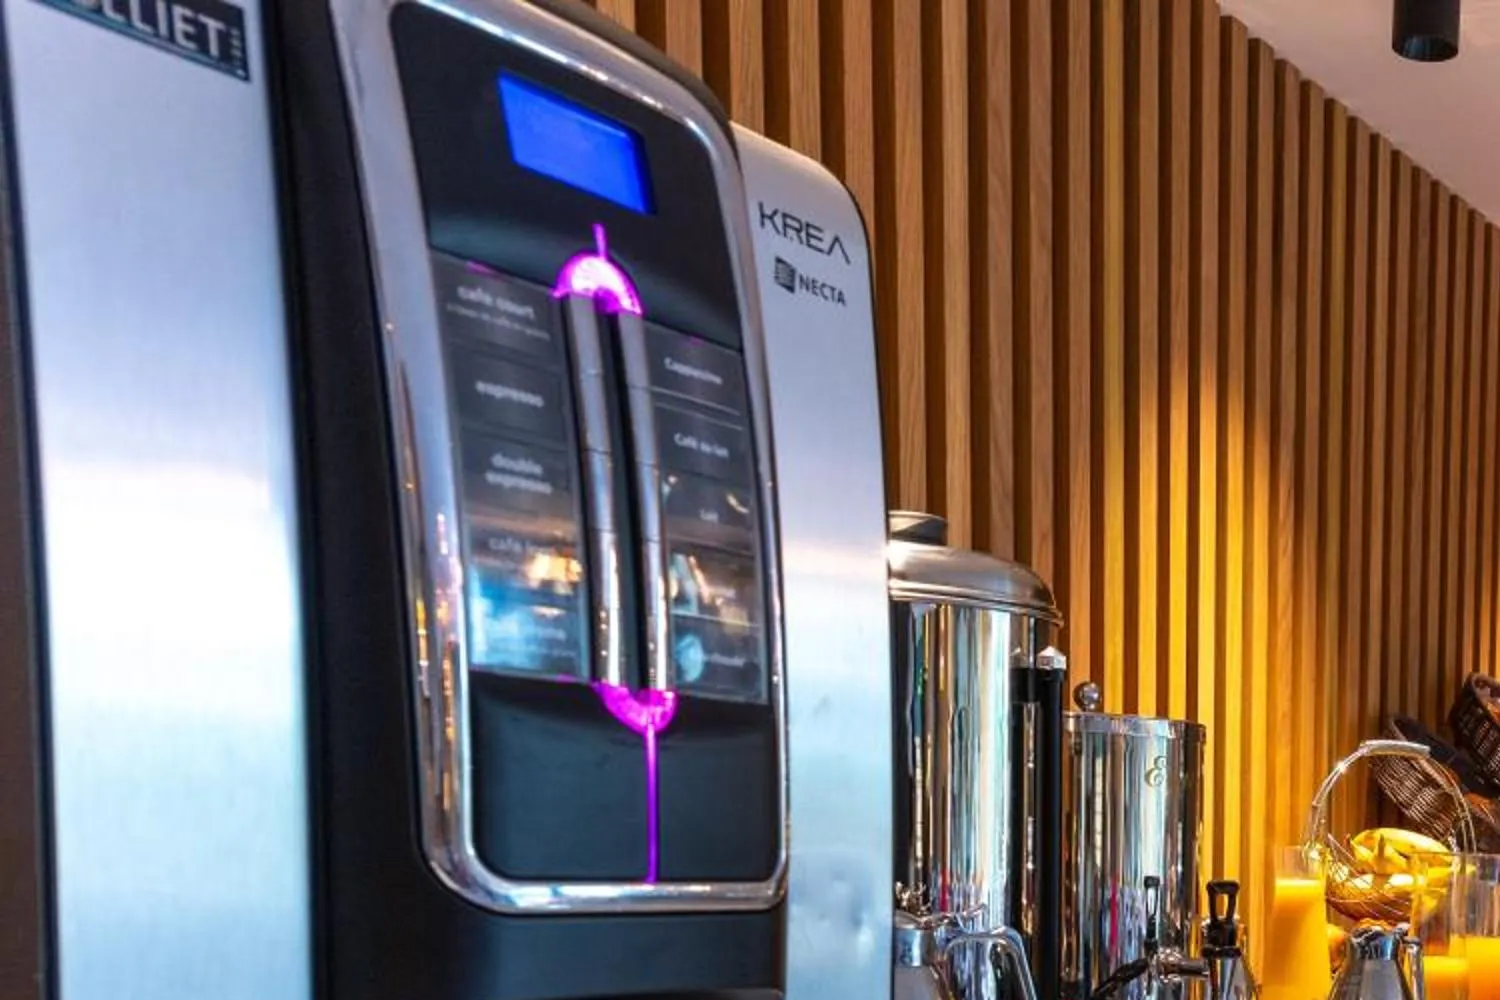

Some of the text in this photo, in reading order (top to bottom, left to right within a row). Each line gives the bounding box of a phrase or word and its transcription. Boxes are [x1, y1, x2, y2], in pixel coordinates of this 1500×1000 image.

[799, 273, 847, 307] NECTA
[475, 380, 545, 407] espresso
[491, 453, 543, 477] double
